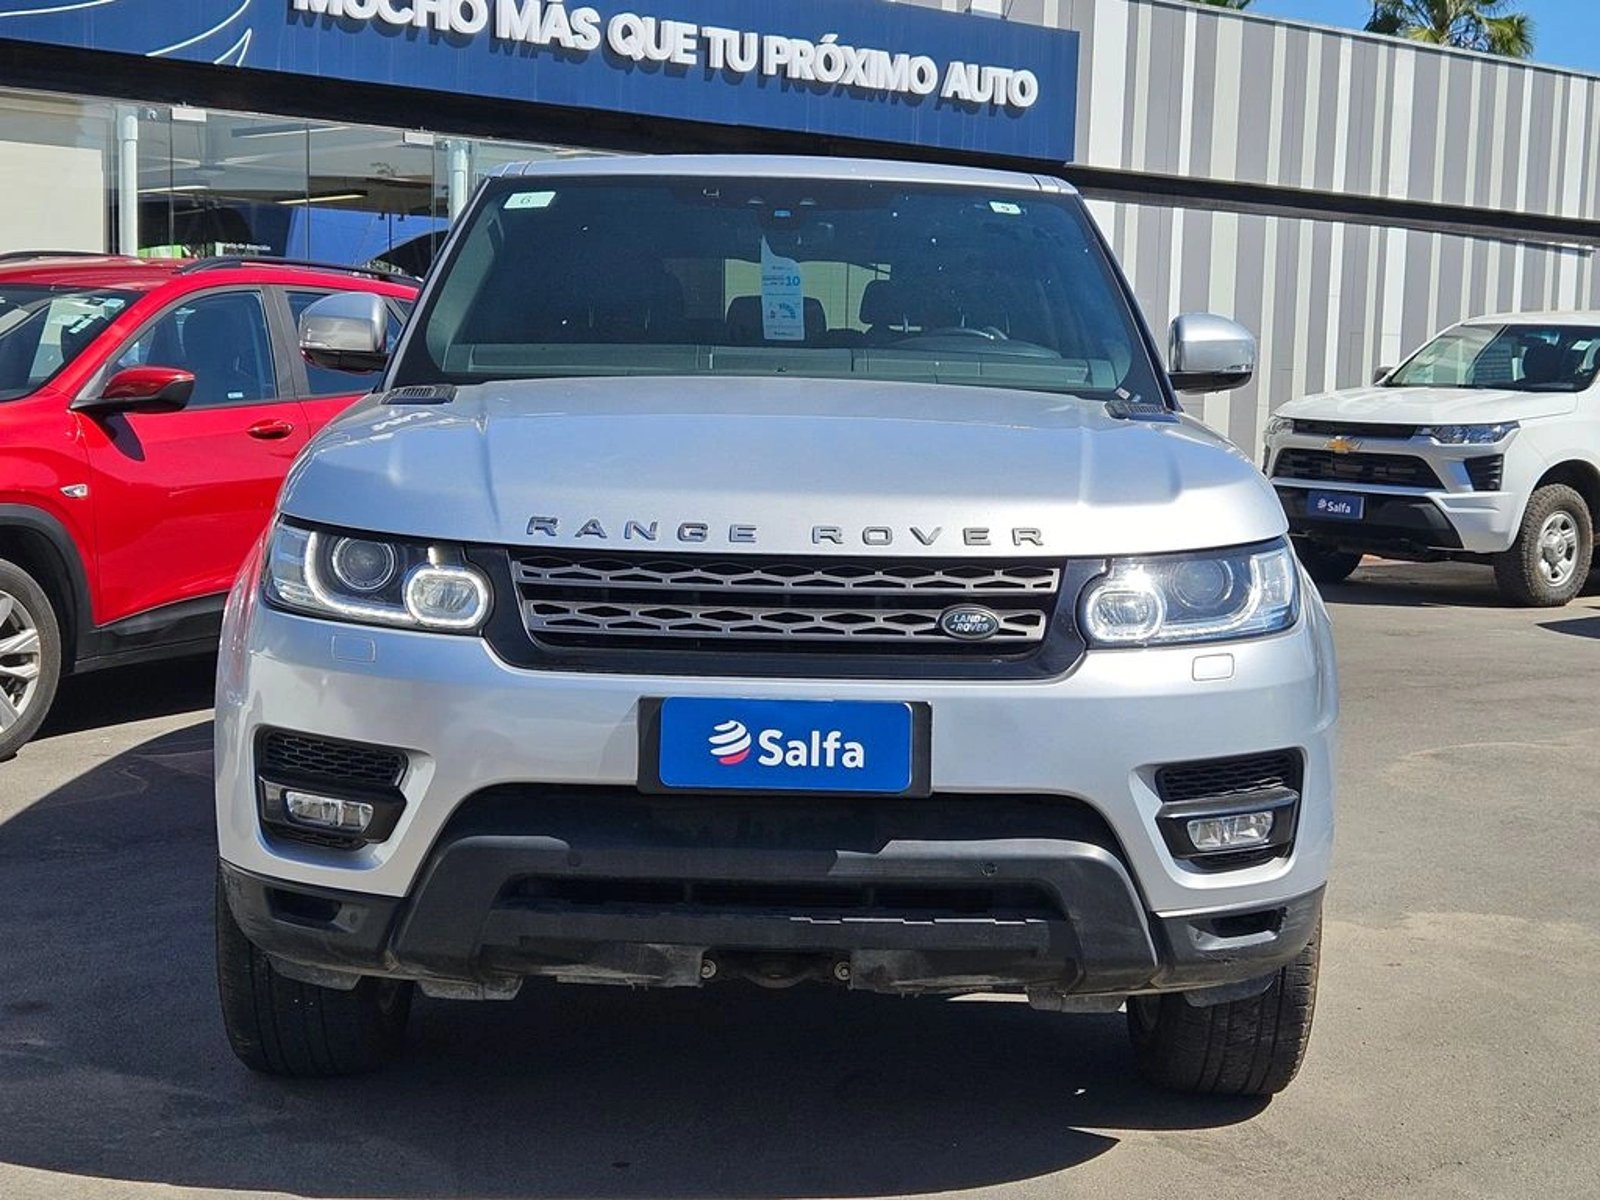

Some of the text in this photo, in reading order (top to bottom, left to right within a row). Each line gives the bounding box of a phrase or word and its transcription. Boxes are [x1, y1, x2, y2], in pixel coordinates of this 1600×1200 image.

[496, 0, 602, 51] MÁS
[606, 12, 698, 65] QUE
[702, 26, 758, 73] TU
[763, 34, 939, 95] PRÓXIMO
[940, 61, 1039, 108] AUTO
[785, 275, 801, 287] 10
[1327, 501, 1351, 514] Salfa
[526, 516, 1044, 546] RANGE ROVER
[953, 614, 981, 623] LAND
[955, 623, 989, 632] ROVER
[758, 729, 865, 769] Salfa
